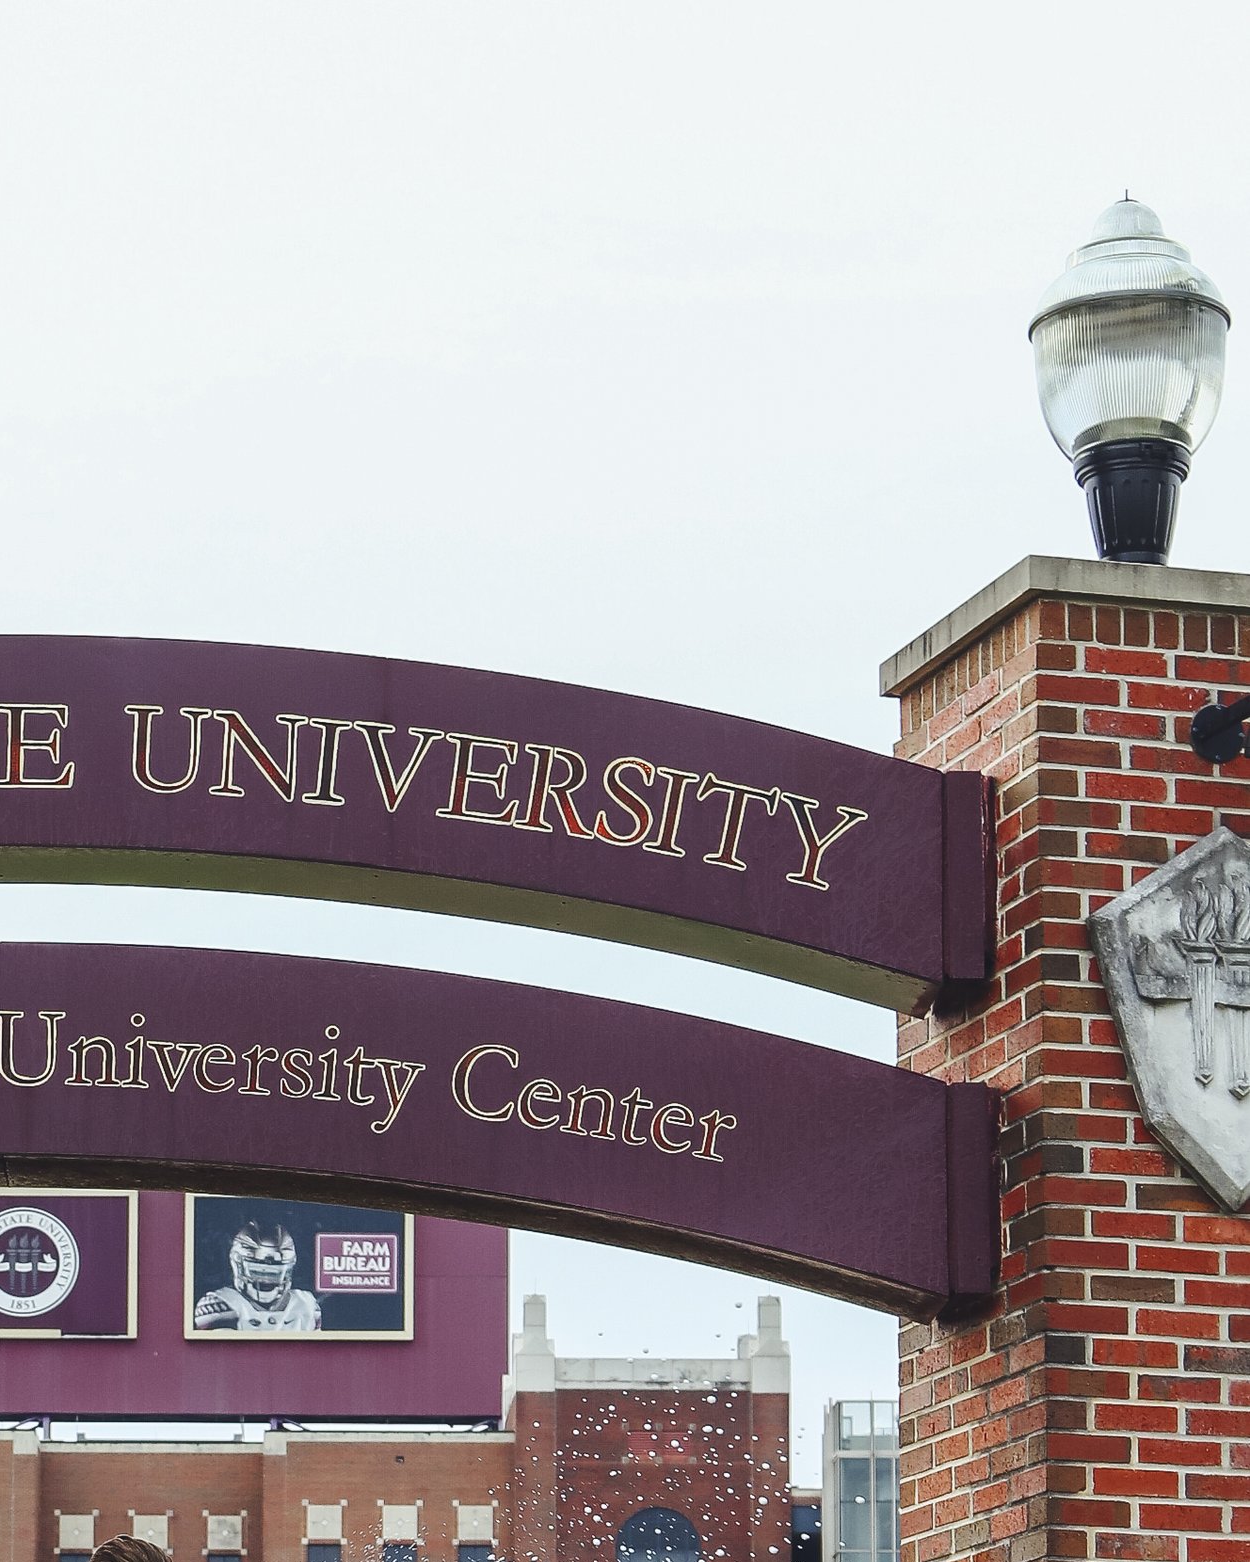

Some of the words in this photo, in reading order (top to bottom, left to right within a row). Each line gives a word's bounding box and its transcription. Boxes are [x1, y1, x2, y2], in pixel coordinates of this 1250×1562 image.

[123, 704, 869, 891] UNIVERSITY
[451, 1044, 737, 1163] Center
[38, 1217, 72, 1290] UNIVERSITY
[342, 1241, 390, 1256] FARM
[323, 1256, 391, 1272] BUREAU
[332, 1276, 391, 1286] INSURANCE
[10, 1299, 37, 1310] 1851
